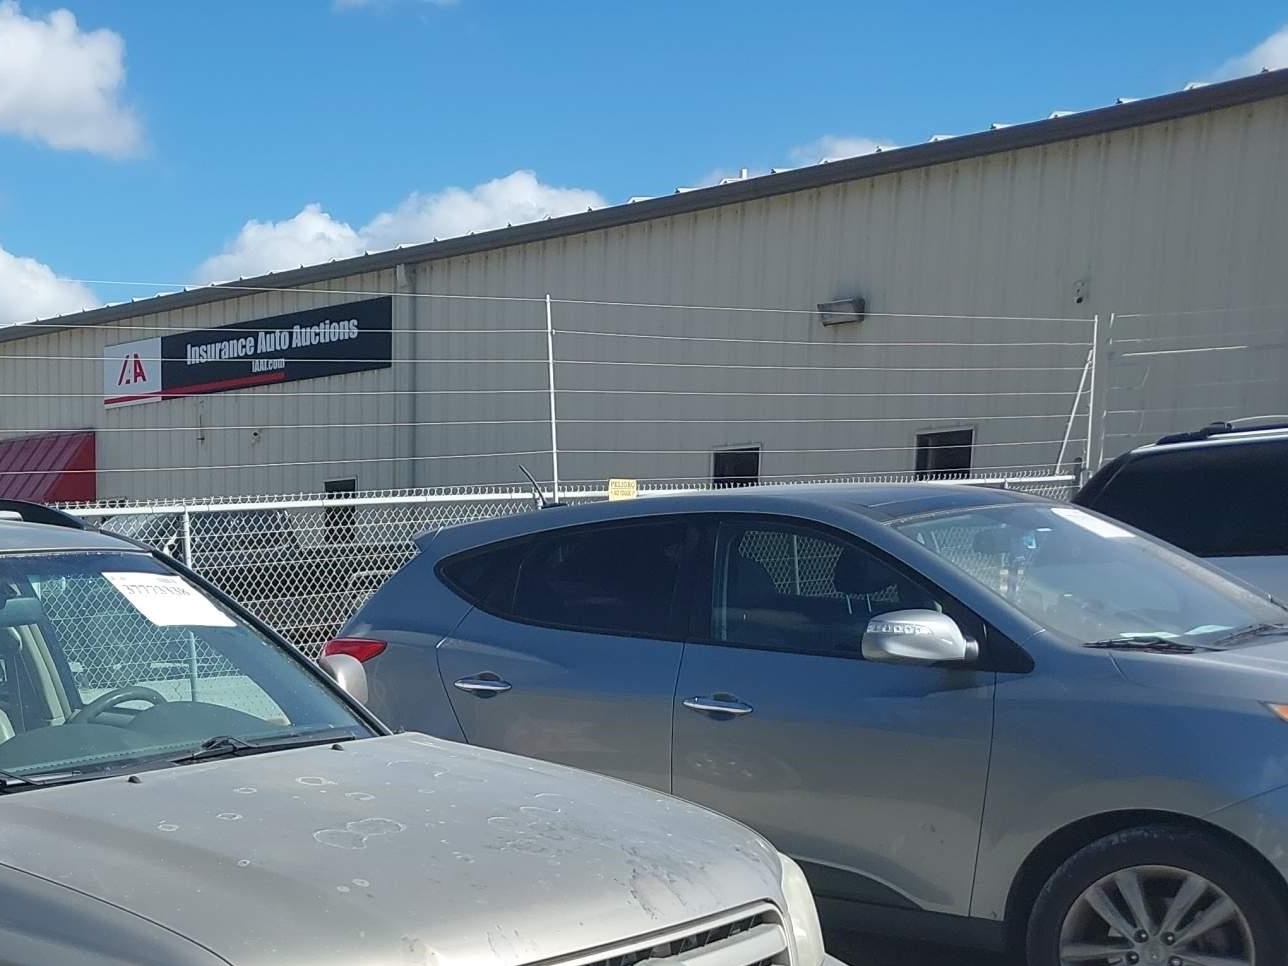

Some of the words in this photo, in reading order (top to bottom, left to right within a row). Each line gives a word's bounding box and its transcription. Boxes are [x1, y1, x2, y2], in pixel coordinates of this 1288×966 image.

[186, 337, 255, 365] Insurance
[257, 330, 289, 354] Auto
[292, 319, 359, 348] Auctions
